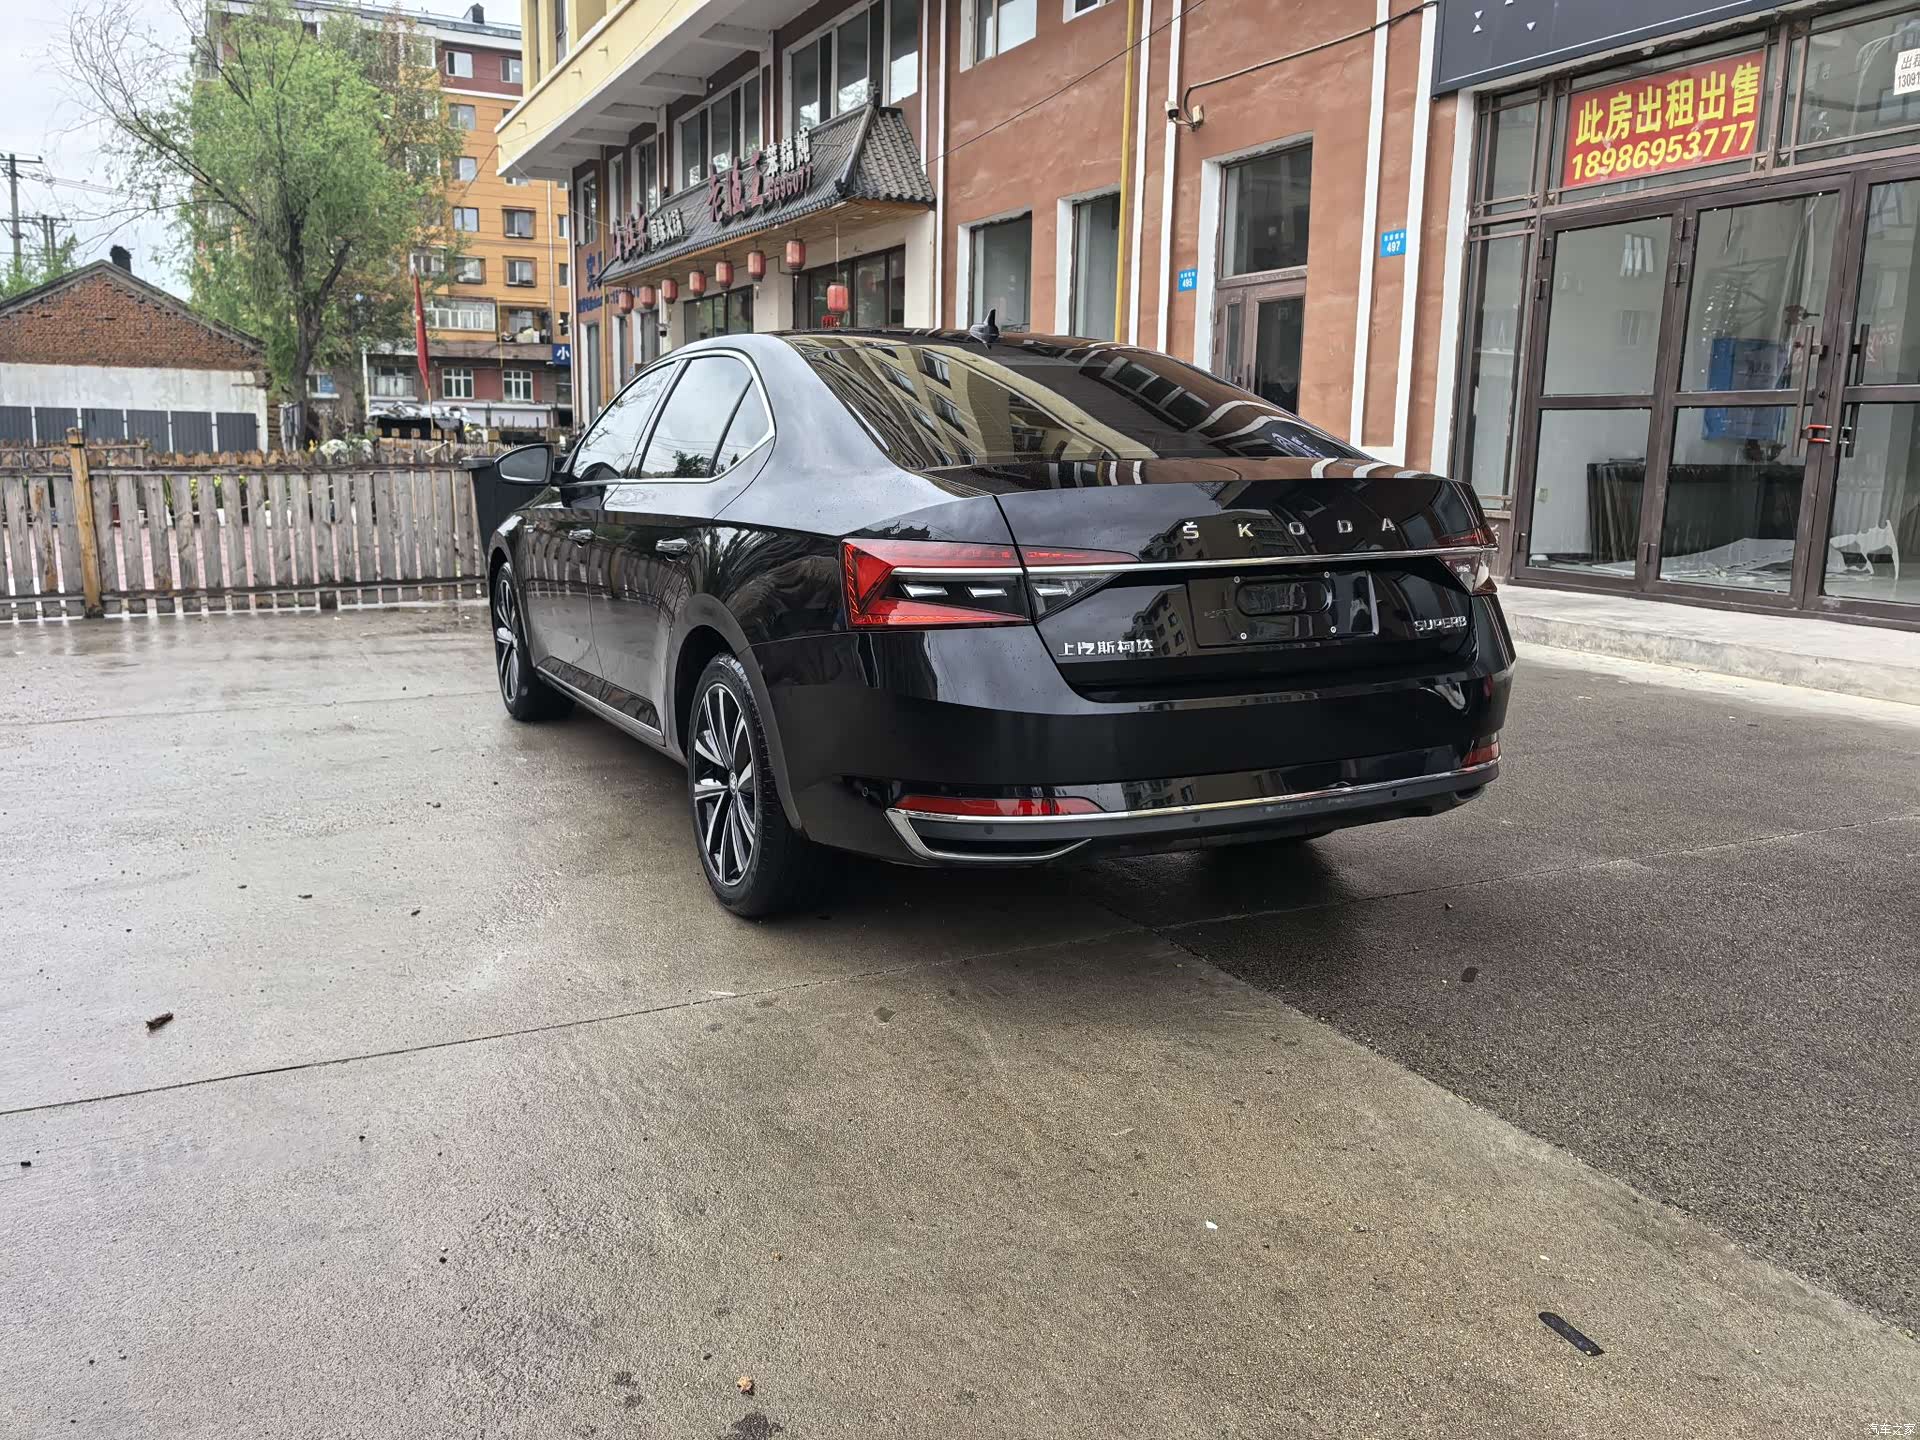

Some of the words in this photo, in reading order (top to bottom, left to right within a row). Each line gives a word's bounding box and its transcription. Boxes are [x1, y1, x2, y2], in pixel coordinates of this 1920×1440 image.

[1575, 62, 1760, 147] 此房出租出售
[1572, 120, 1755, 180] 18986953777
[1387, 240, 1401, 253] 497
[1182, 517, 1396, 540] ŠKODA
[1413, 615, 1468, 632] SUPERB
[1058, 639, 1154, 656] 上汽斯柯达
